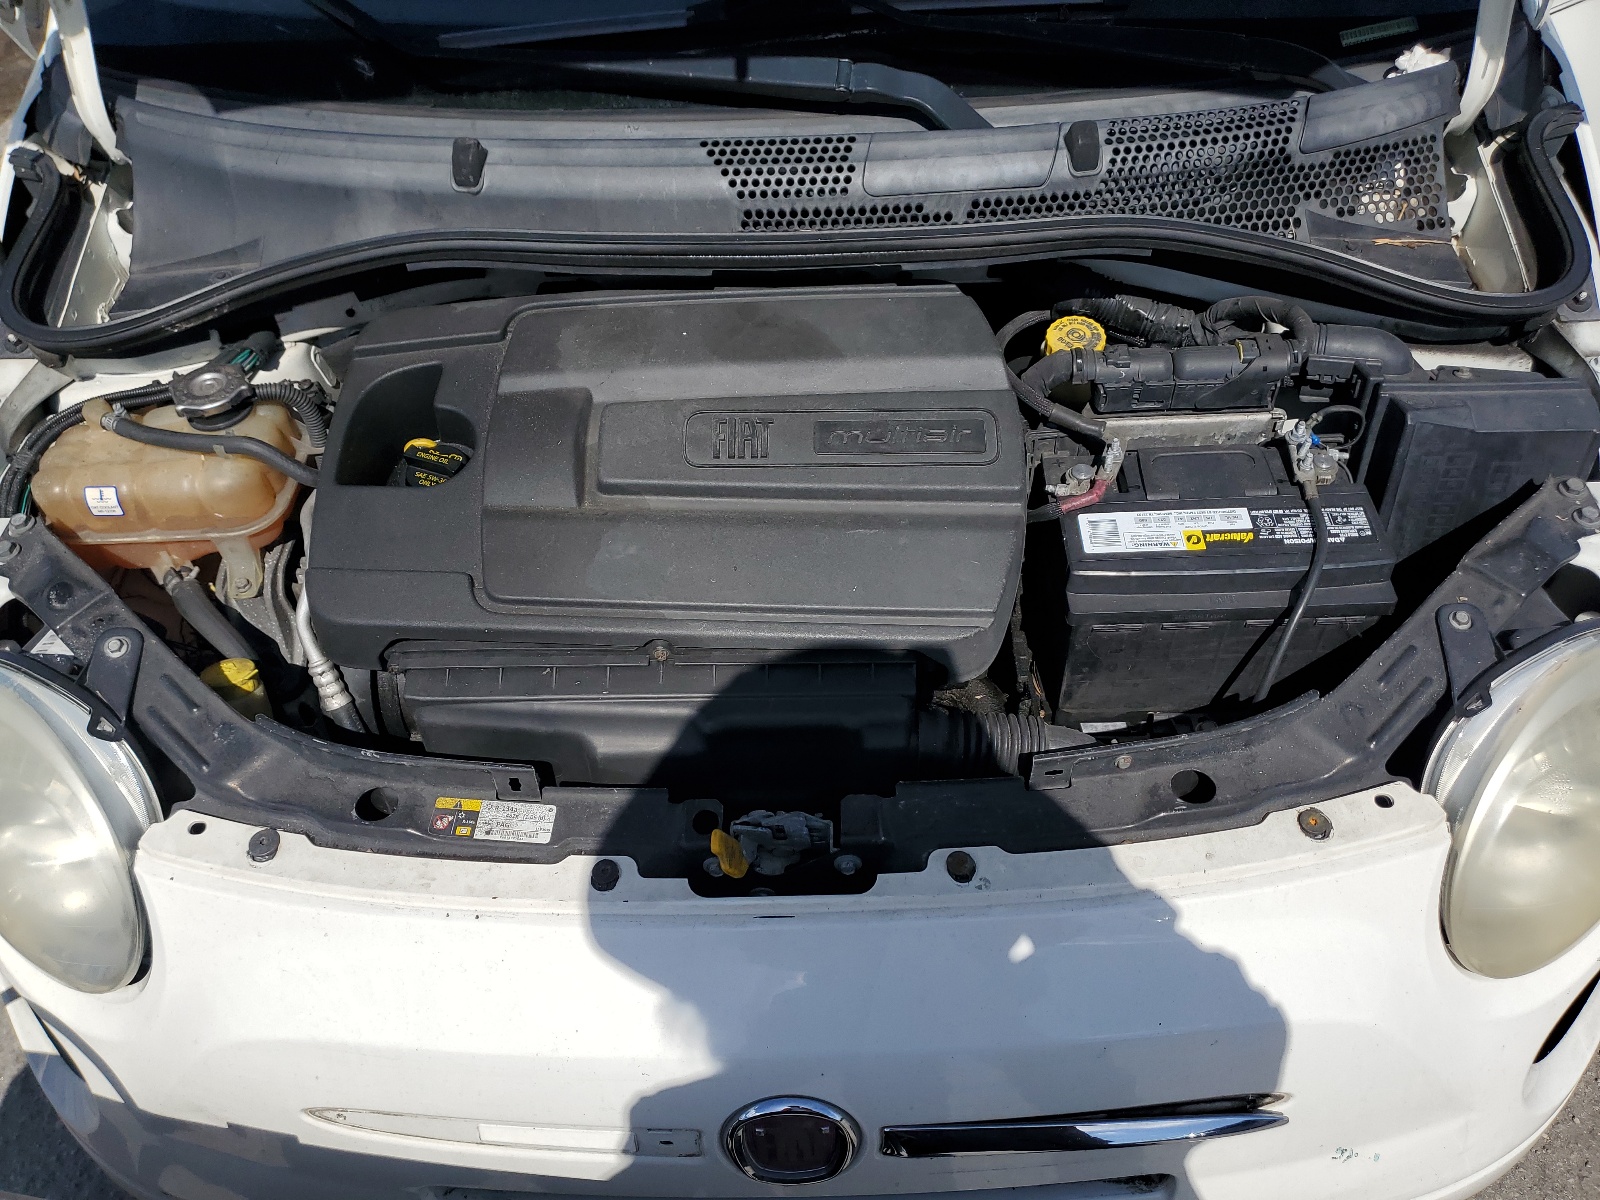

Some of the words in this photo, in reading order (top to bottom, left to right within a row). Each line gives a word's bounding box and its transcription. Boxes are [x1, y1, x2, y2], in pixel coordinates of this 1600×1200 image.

[712, 417, 774, 459] FIAT
[826, 424, 973, 445] multiair
[416, 452, 438, 461] ENGINE
